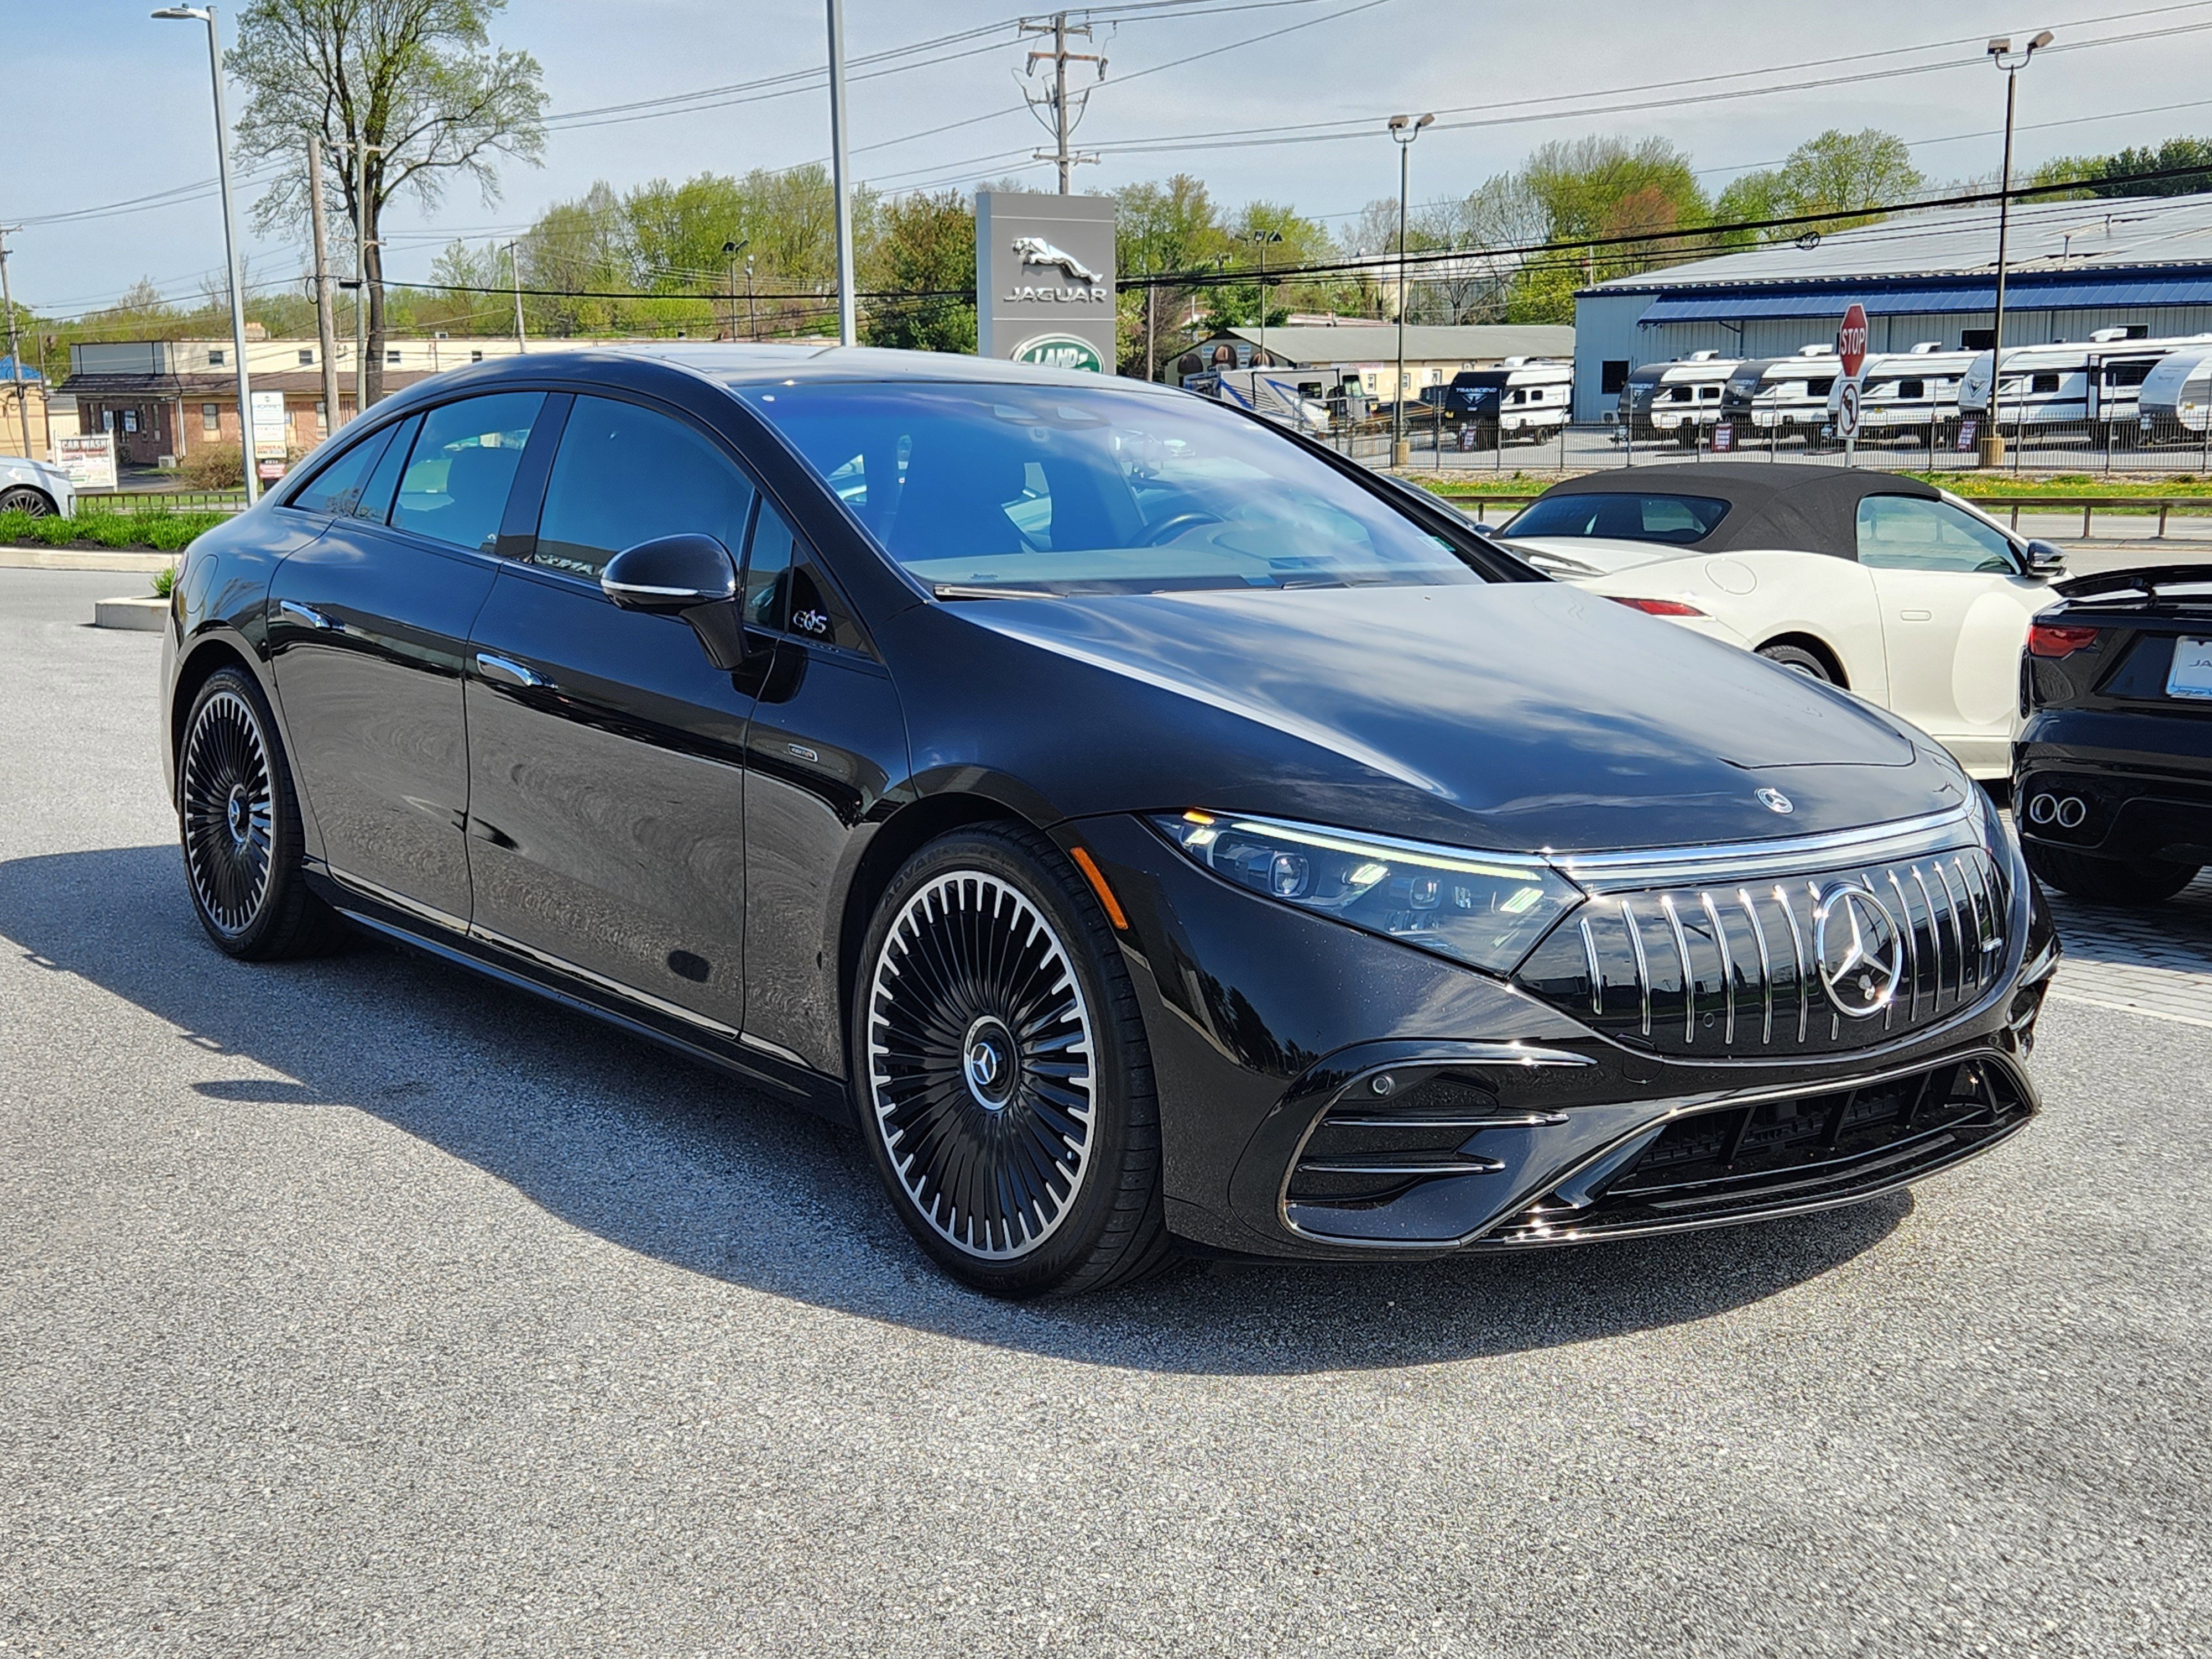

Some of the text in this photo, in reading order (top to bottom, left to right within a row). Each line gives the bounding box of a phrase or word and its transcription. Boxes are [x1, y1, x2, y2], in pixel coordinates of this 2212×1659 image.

[1003, 286, 1107, 302] JAGUAR
[1841, 327, 1865, 355] STOP
[61, 439, 107, 450] CAR WASH
[793, 609, 827, 634] EQS
